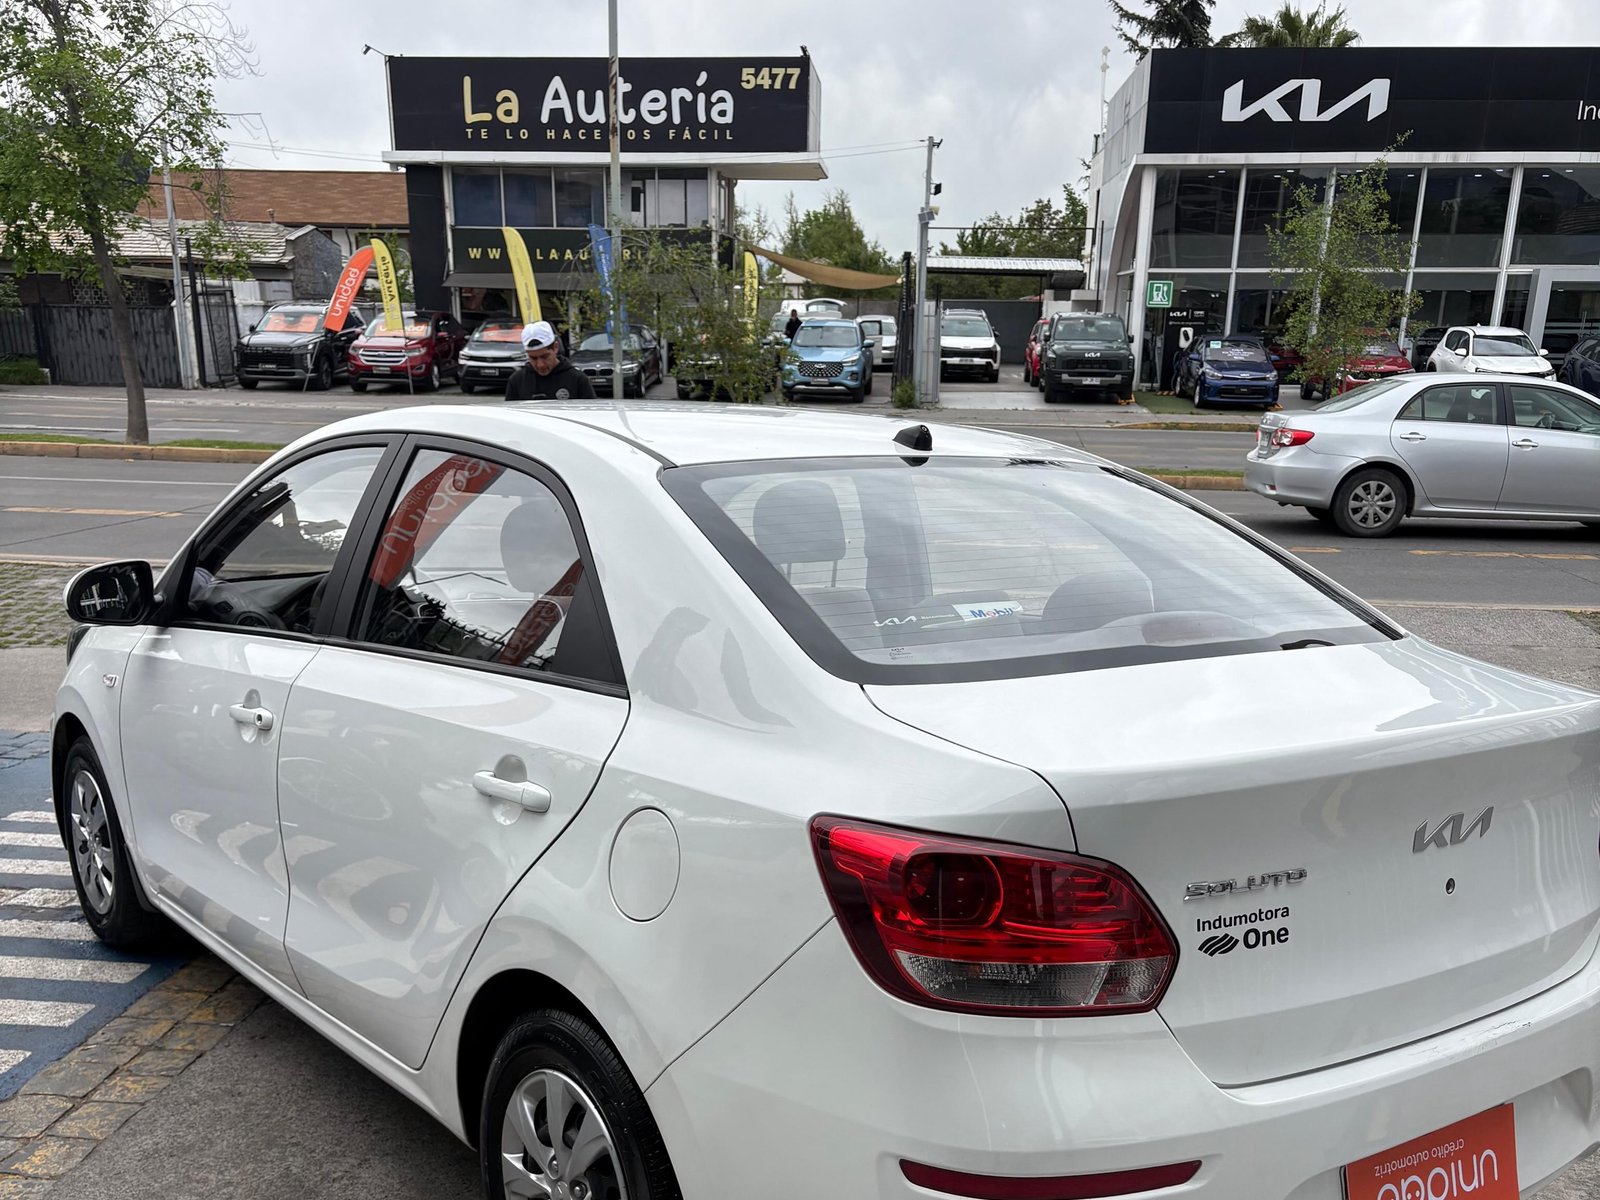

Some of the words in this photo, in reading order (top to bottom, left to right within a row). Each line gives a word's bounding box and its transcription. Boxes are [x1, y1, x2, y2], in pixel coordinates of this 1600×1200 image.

[741, 67, 801, 90] 5477
[462, 75, 520, 124] La
[539, 70, 735, 125] Autería
[1221, 78, 1391, 122] KIA
[1577, 100, 1600, 120] In
[465, 128, 489, 140] TE
[505, 128, 530, 140] LO
[546, 128, 652, 140] HACEOS
[668, 125, 734, 140] FÁCIL
[331, 267, 361, 317] unidad
[1412, 806, 1494, 855] KIA
[1183, 867, 1308, 903] SOLUTO
[1196, 905, 1290, 933] Indumotora
[1243, 926, 1290, 951] One
[1431, 1138, 1465, 1160] crédito
[1374, 1149, 1430, 1179] automotriz
